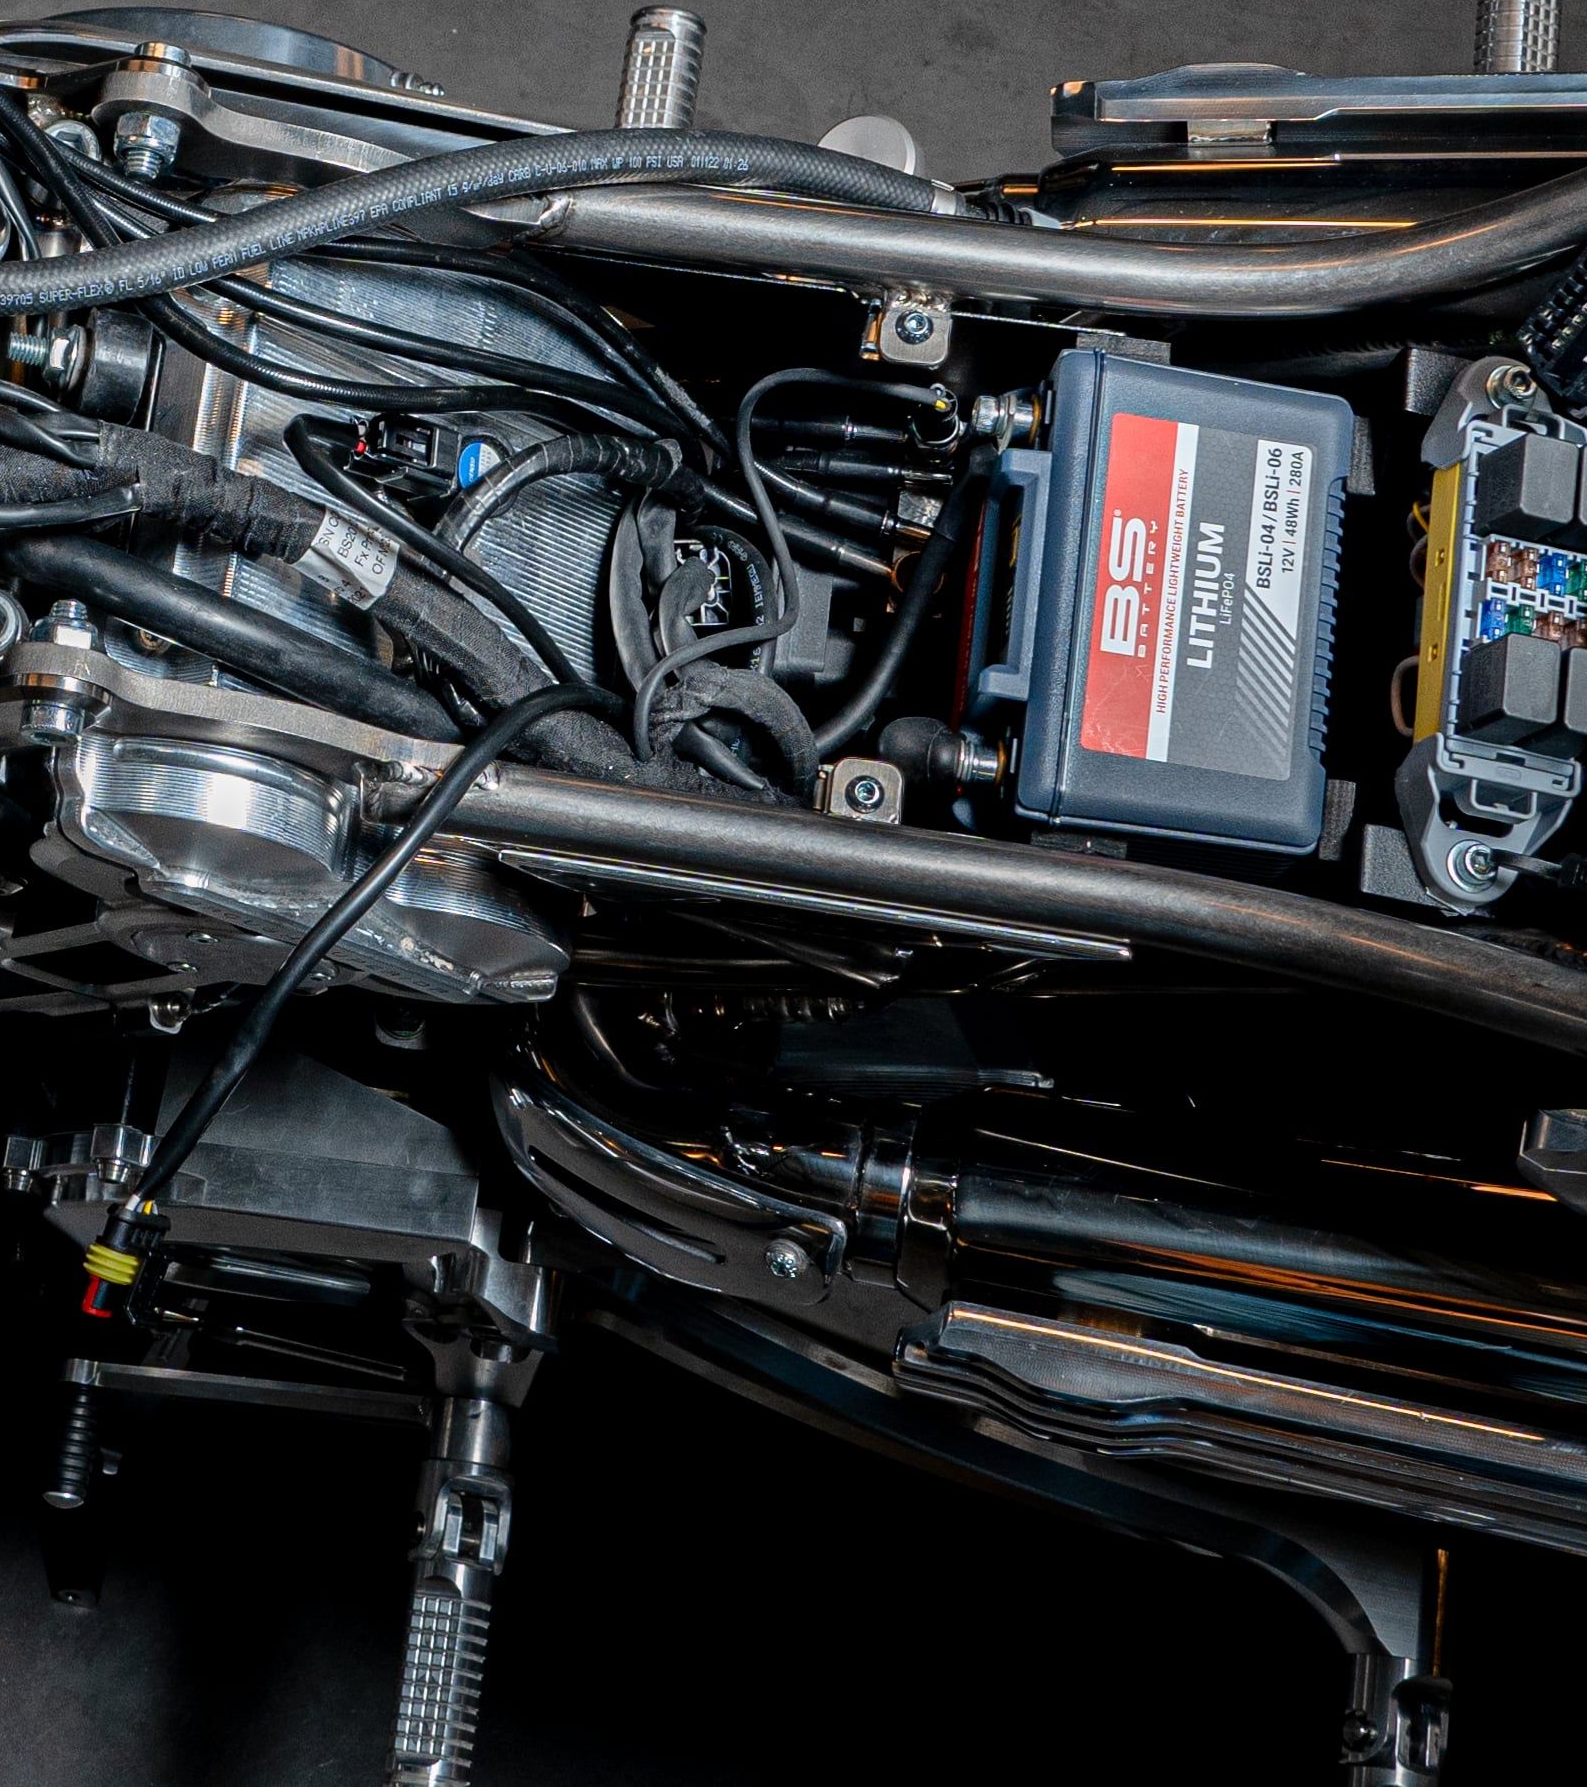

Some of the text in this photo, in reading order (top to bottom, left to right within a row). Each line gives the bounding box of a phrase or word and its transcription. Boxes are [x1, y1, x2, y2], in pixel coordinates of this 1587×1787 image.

[0, 293, 34, 306] 39705
[119, 280, 133, 293] FL
[173, 266, 185, 280] ID
[189, 260, 208, 276] LOW
[212, 249, 238, 270] PERM
[241, 243, 267, 261] FUEL
[270, 231, 296, 250] LINE
[370, 202, 389, 219] EPA
[392, 187, 442, 211] COMPLIANT
[447, 183, 458, 197] 15
[508, 166, 531, 183] CARB
[629, 156, 642, 168] 100
[645, 155, 662, 168] PSI
[667, 155, 685, 168] USA
[1281, 451, 1305, 574] 12V 48Wh 280A
[1100, 516, 1147, 657] BS
[1138, 521, 1159, 658] BATTERY
[1156, 468, 1189, 714] HIGH PERFORMANCE LIGHTWEIGHT BATTERY
[1186, 522, 1225, 670] LITHIUM
[1219, 572, 1236, 625] LiFePO4
